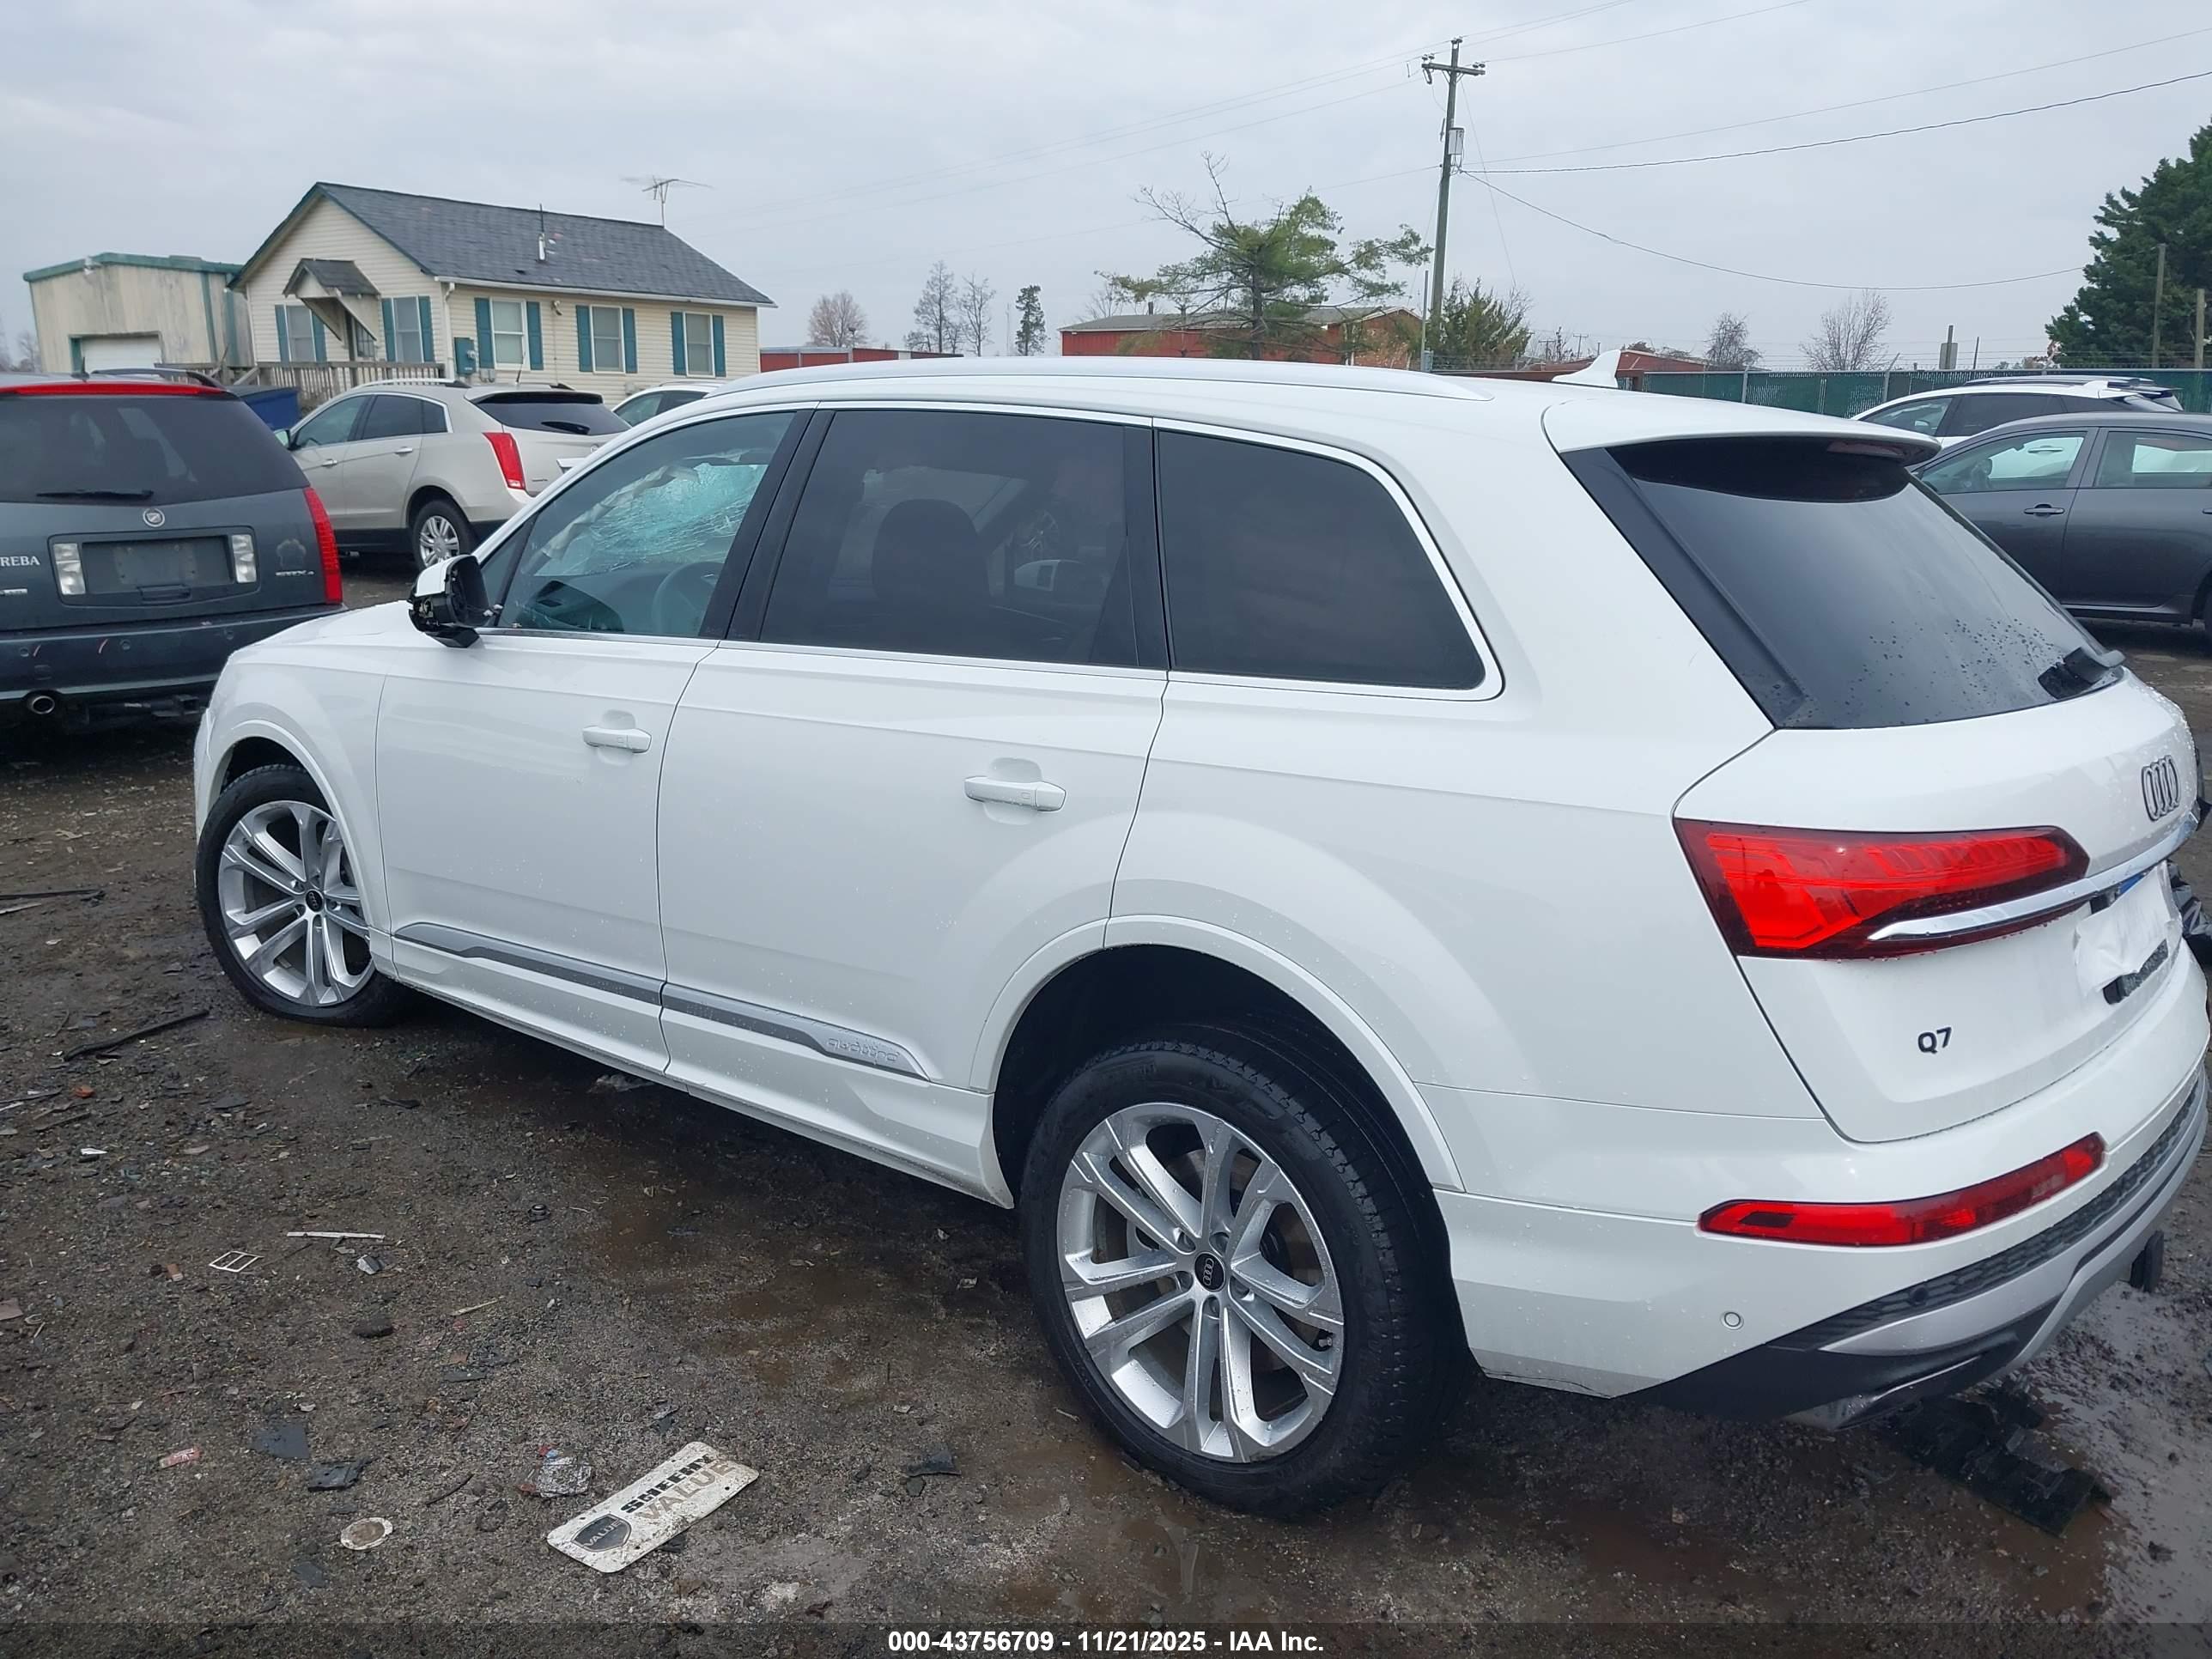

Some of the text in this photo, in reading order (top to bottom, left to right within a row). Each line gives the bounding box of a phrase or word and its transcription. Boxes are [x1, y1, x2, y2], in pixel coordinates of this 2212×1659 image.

[827, 1037, 901, 1063] quattro
[1917, 1026, 1952, 1054] Q7
[635, 1460, 737, 1520] VALUE
[583, 1519, 623, 1547] VALUE
